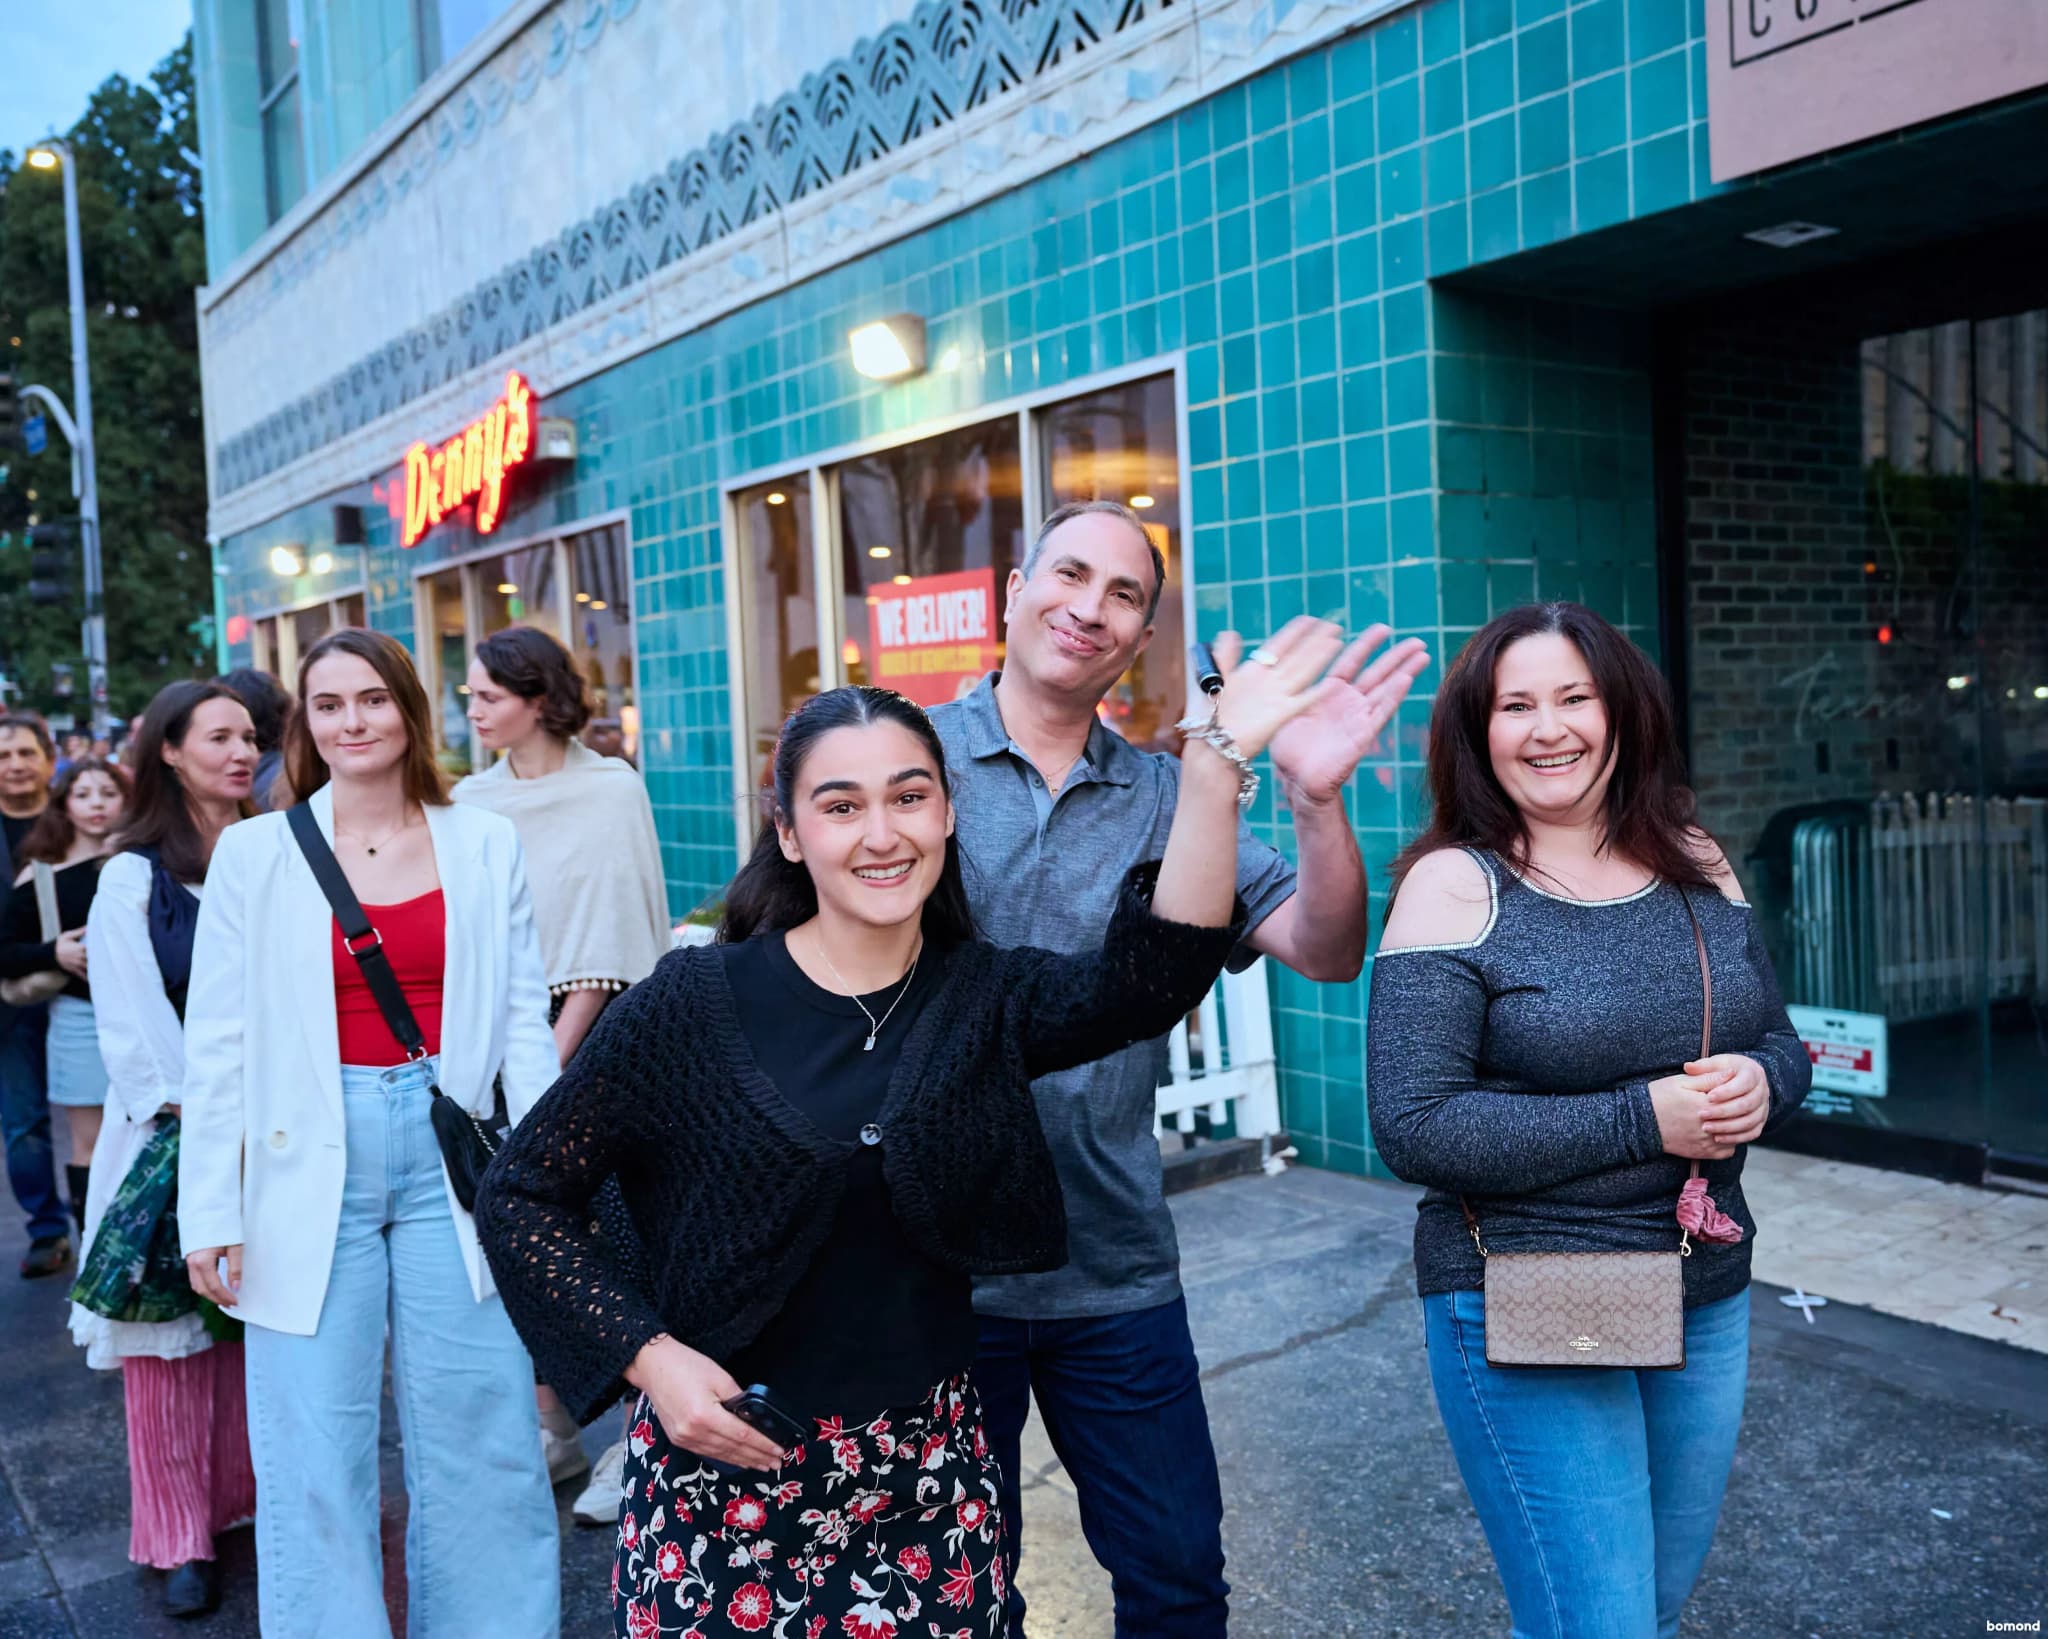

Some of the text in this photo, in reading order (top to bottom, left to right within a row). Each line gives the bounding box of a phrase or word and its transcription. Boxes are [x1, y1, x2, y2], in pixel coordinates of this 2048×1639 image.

[402, 370, 534, 547] Denny's
[876, 587, 987, 647] WE DELIVER!
